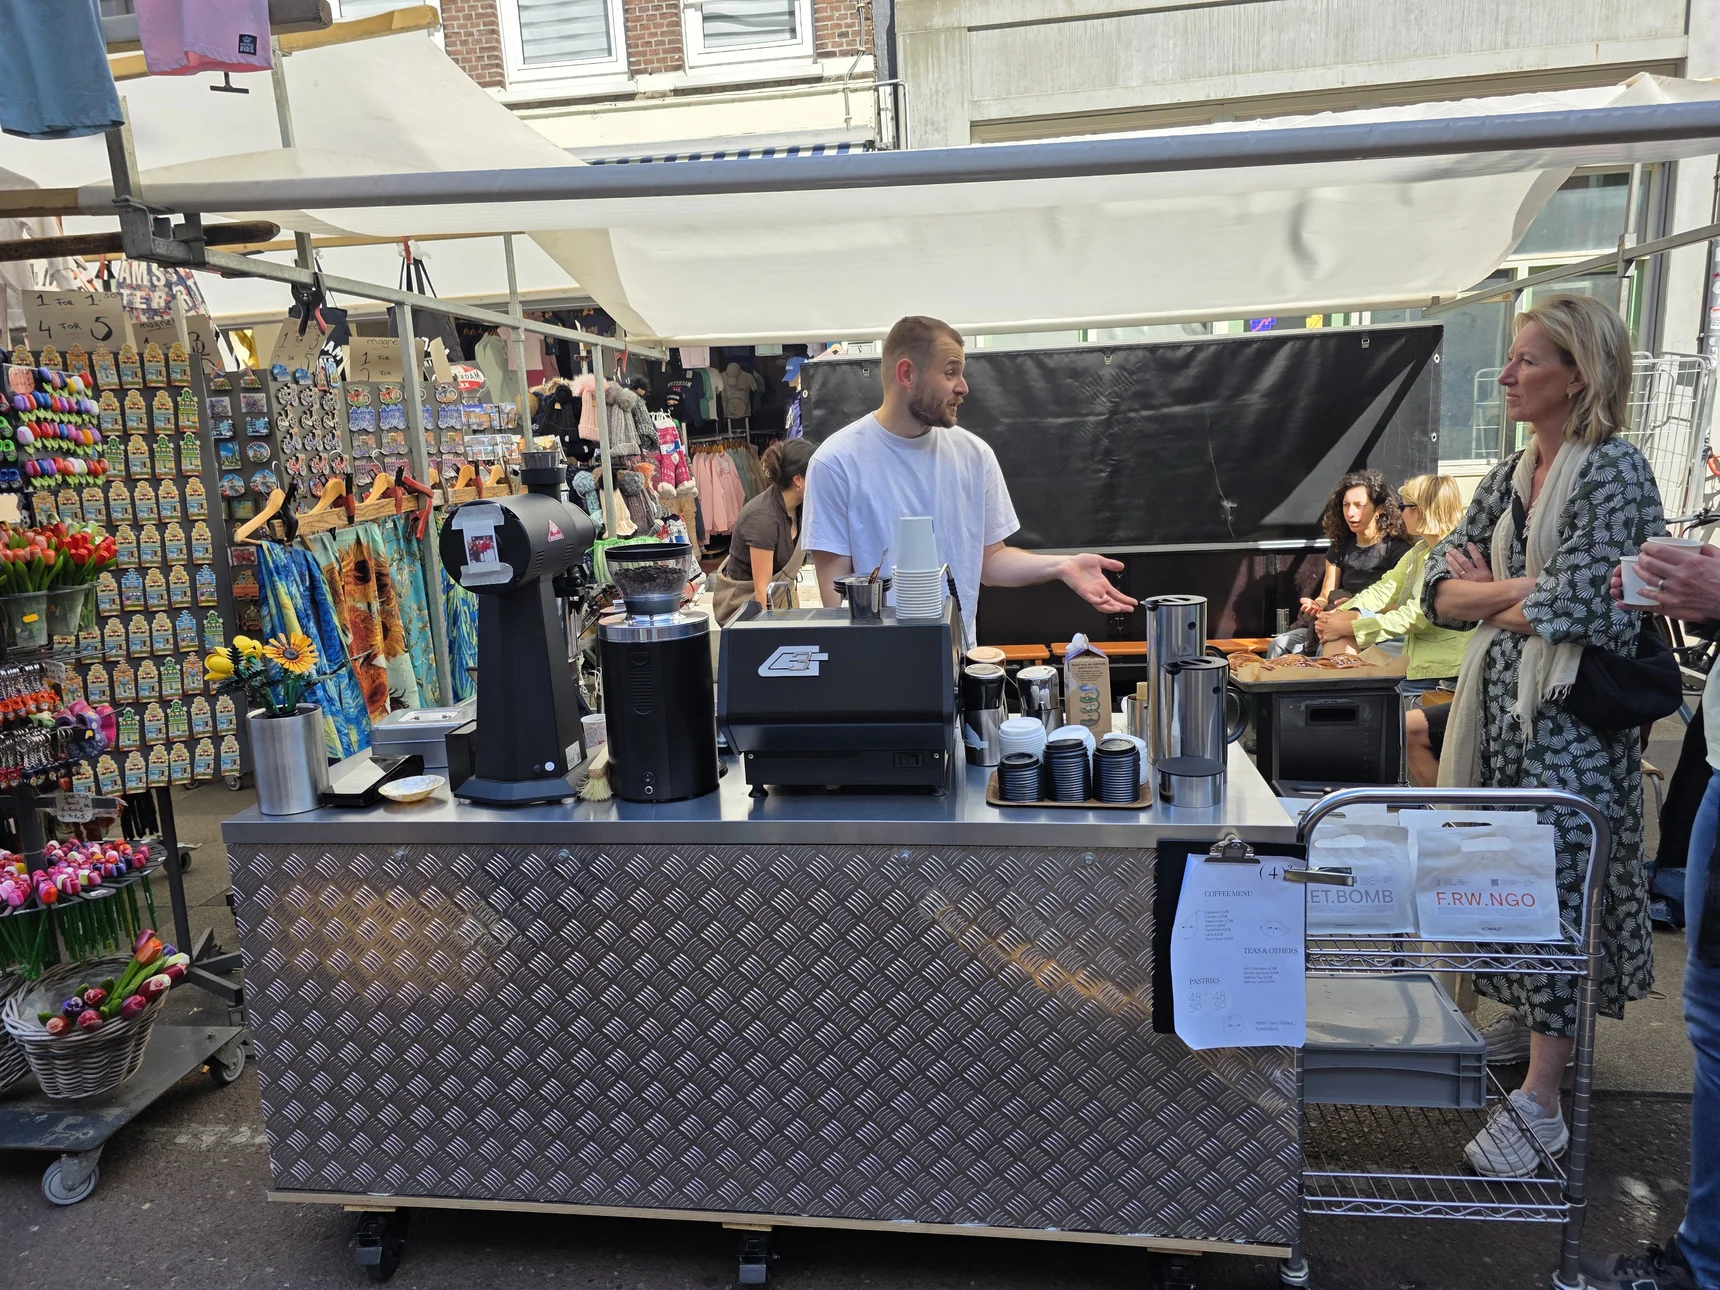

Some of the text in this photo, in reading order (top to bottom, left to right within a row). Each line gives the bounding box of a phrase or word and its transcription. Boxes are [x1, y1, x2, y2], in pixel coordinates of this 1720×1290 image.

[37, 293, 49, 307] 1
[39, 320, 52, 339] 4
[90, 316, 113, 341] 5
[308, 334, 320, 350] 3
[367, 339, 400, 348] magne
[361, 351, 371, 367] 1
[1436, 892, 1536, 908] F.RW.NGO
[1189, 977, 1221, 985] PASTRIES
